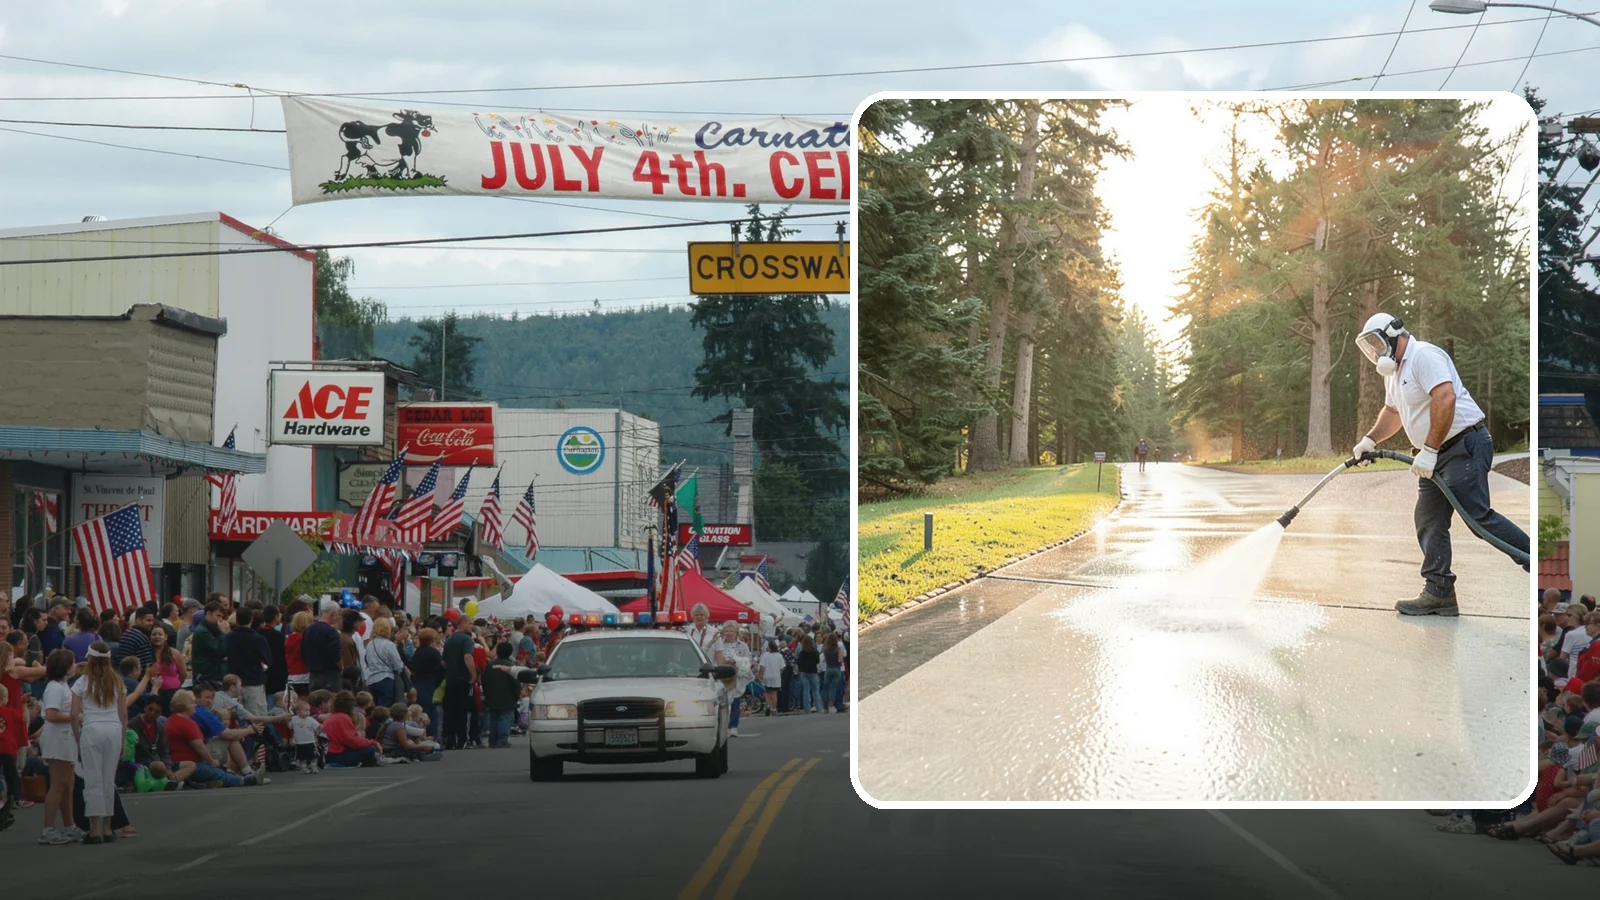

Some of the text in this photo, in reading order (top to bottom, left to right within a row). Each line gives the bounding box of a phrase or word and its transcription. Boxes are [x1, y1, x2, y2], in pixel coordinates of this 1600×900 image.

[695, 121, 850, 150] Carnat
[481, 141, 605, 192] JULY
[632, 150, 746, 198] 4th.
[697, 254, 850, 280] CROSSWA
[282, 380, 373, 420] ACE
[405, 409, 485, 422] CEDAR LOG
[283, 421, 371, 436] Hardware
[96, 485, 124, 495] Vincent
[126, 486, 136, 495] de
[137, 485, 155, 495] Paul
[688, 526, 742, 535] CRNATION
[699, 535, 730, 543] GLASS
